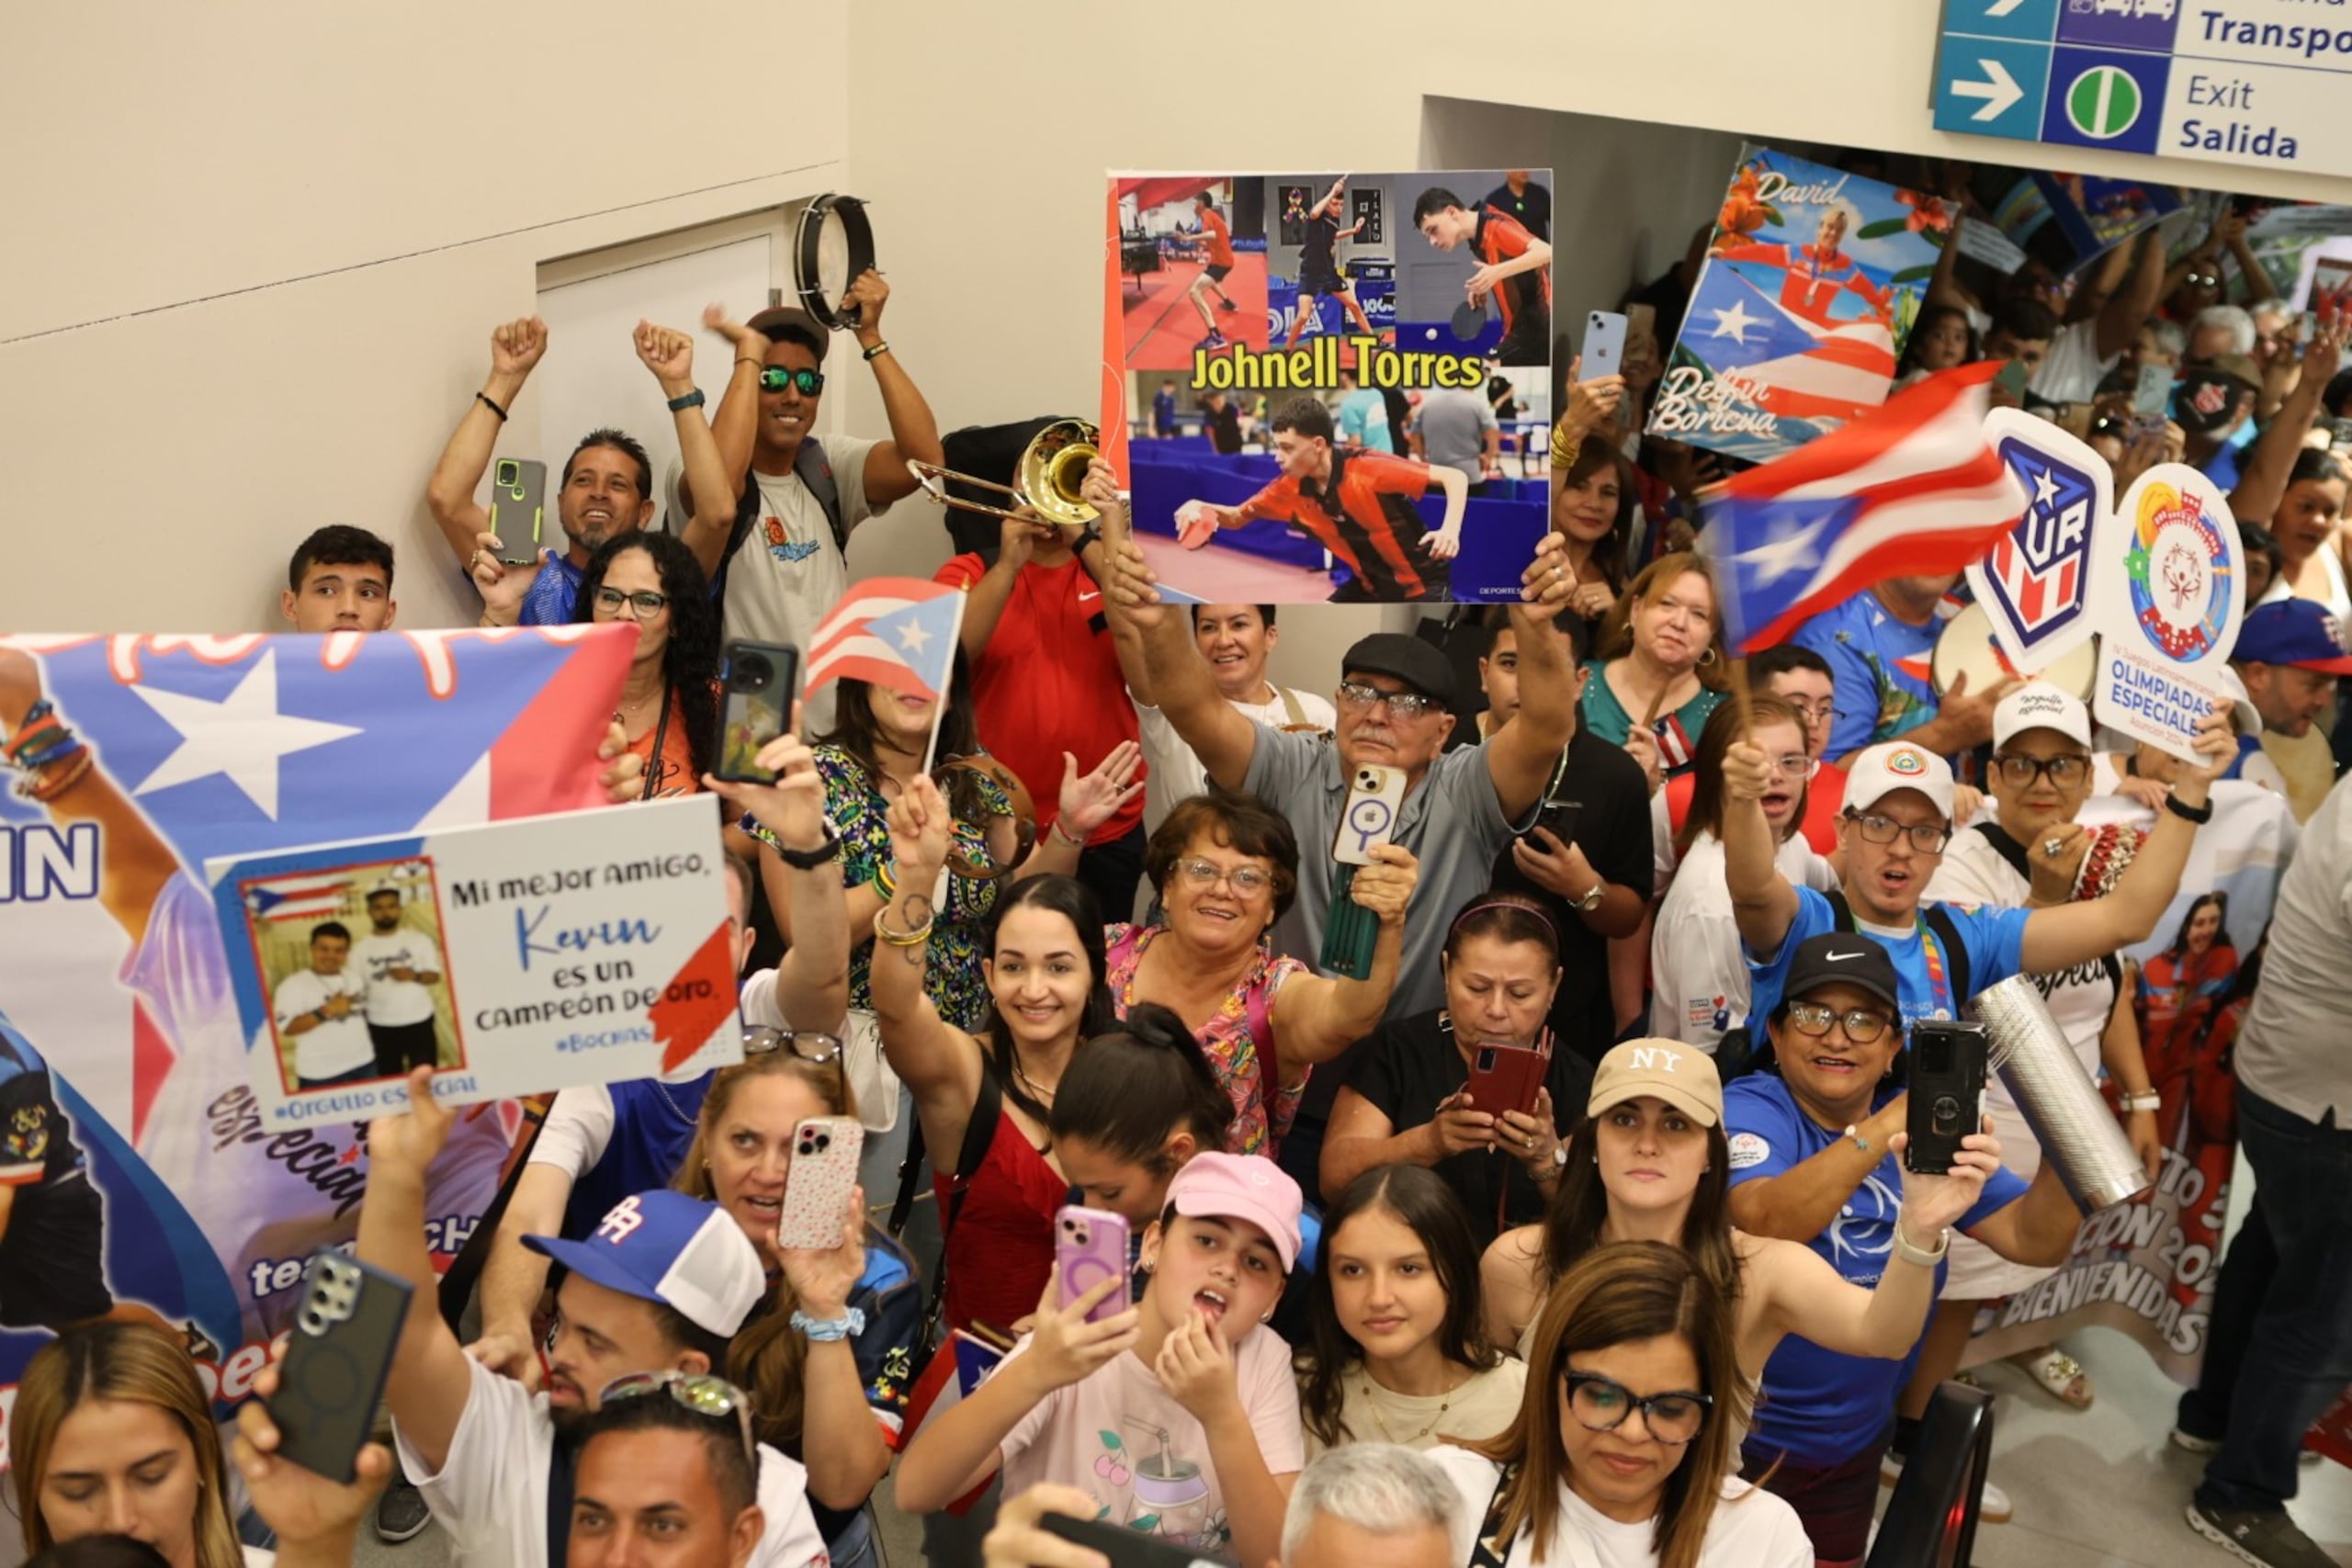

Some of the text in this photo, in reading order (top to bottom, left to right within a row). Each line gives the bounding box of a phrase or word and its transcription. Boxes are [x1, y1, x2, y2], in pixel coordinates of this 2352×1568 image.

[2200, 11, 2352, 58] Transpo
[2187, 75, 2255, 109] Exit
[2179, 119, 2298, 159] Salida
[1754, 172, 1850, 206] David
[1192, 336, 1484, 389] Johnell Torres
[1654, 397, 1778, 434] Boricua
[2111, 659, 2214, 717] OLIMPIADAS
[2111, 682, 2201, 738] ESPECIALE
[450, 879, 490, 908] Mi
[515, 904, 662, 972] Kevin
[553, 960, 634, 989] es un
[1629, 1047, 1683, 1073] NY
[1999, 1257, 2210, 1356] BIENVENIDAS
